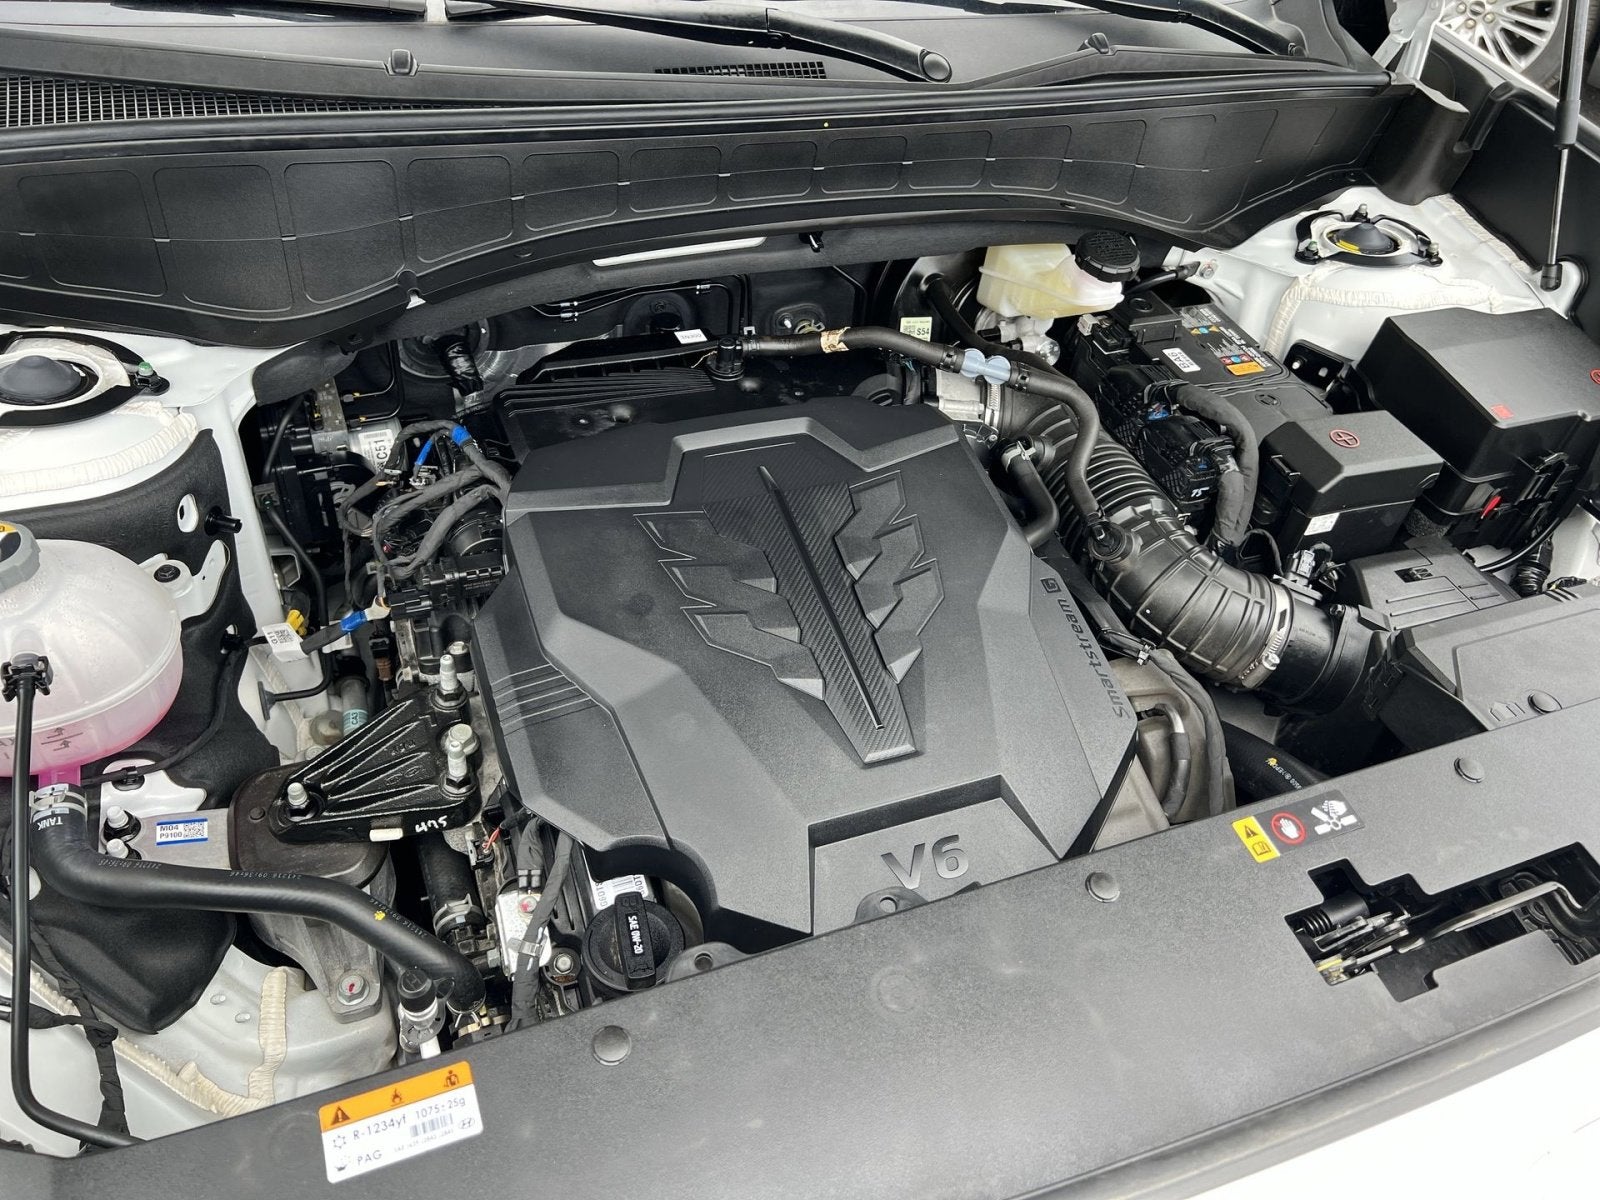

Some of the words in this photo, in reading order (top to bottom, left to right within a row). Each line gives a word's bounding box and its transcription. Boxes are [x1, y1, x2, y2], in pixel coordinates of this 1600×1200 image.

[917, 328, 930, 336] S54
[374, 440, 388, 460] C51
[1057, 598, 1131, 720] Smartstream
[37, 817, 63, 831] TANK
[159, 824, 179, 832] M04
[881, 834, 969, 890] V6
[628, 915, 640, 931] SAE
[631, 930, 644, 955] 0W-20
[353, 1113, 407, 1141] R-1234yf
[357, 1149, 383, 1166] PAG
